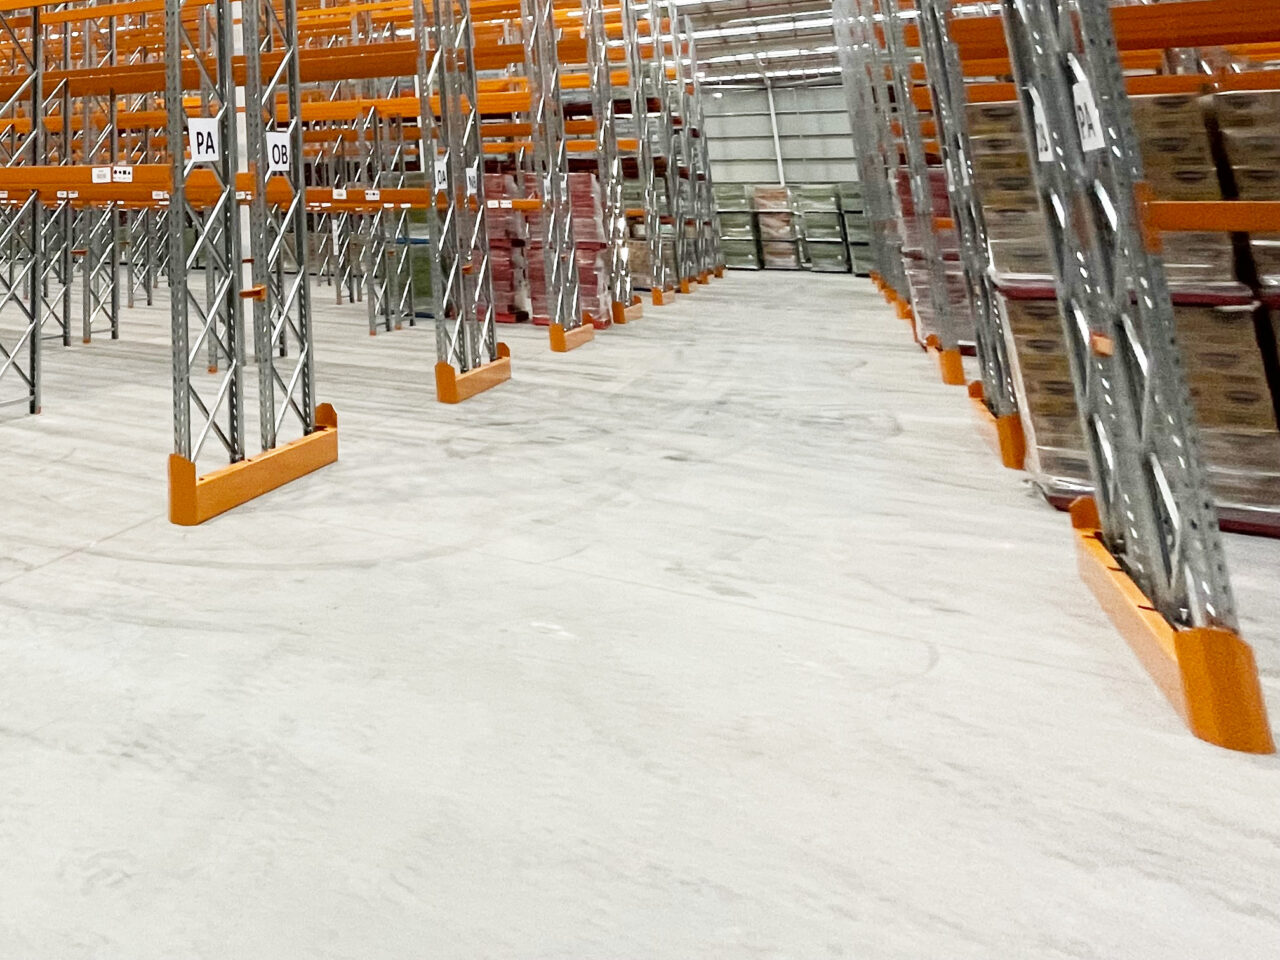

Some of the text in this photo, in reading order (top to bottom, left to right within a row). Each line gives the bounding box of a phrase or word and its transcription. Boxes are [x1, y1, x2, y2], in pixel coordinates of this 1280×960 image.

[1077, 102, 1096, 139] PA
[196, 131, 216, 155] PA
[271, 143, 288, 165] OB
